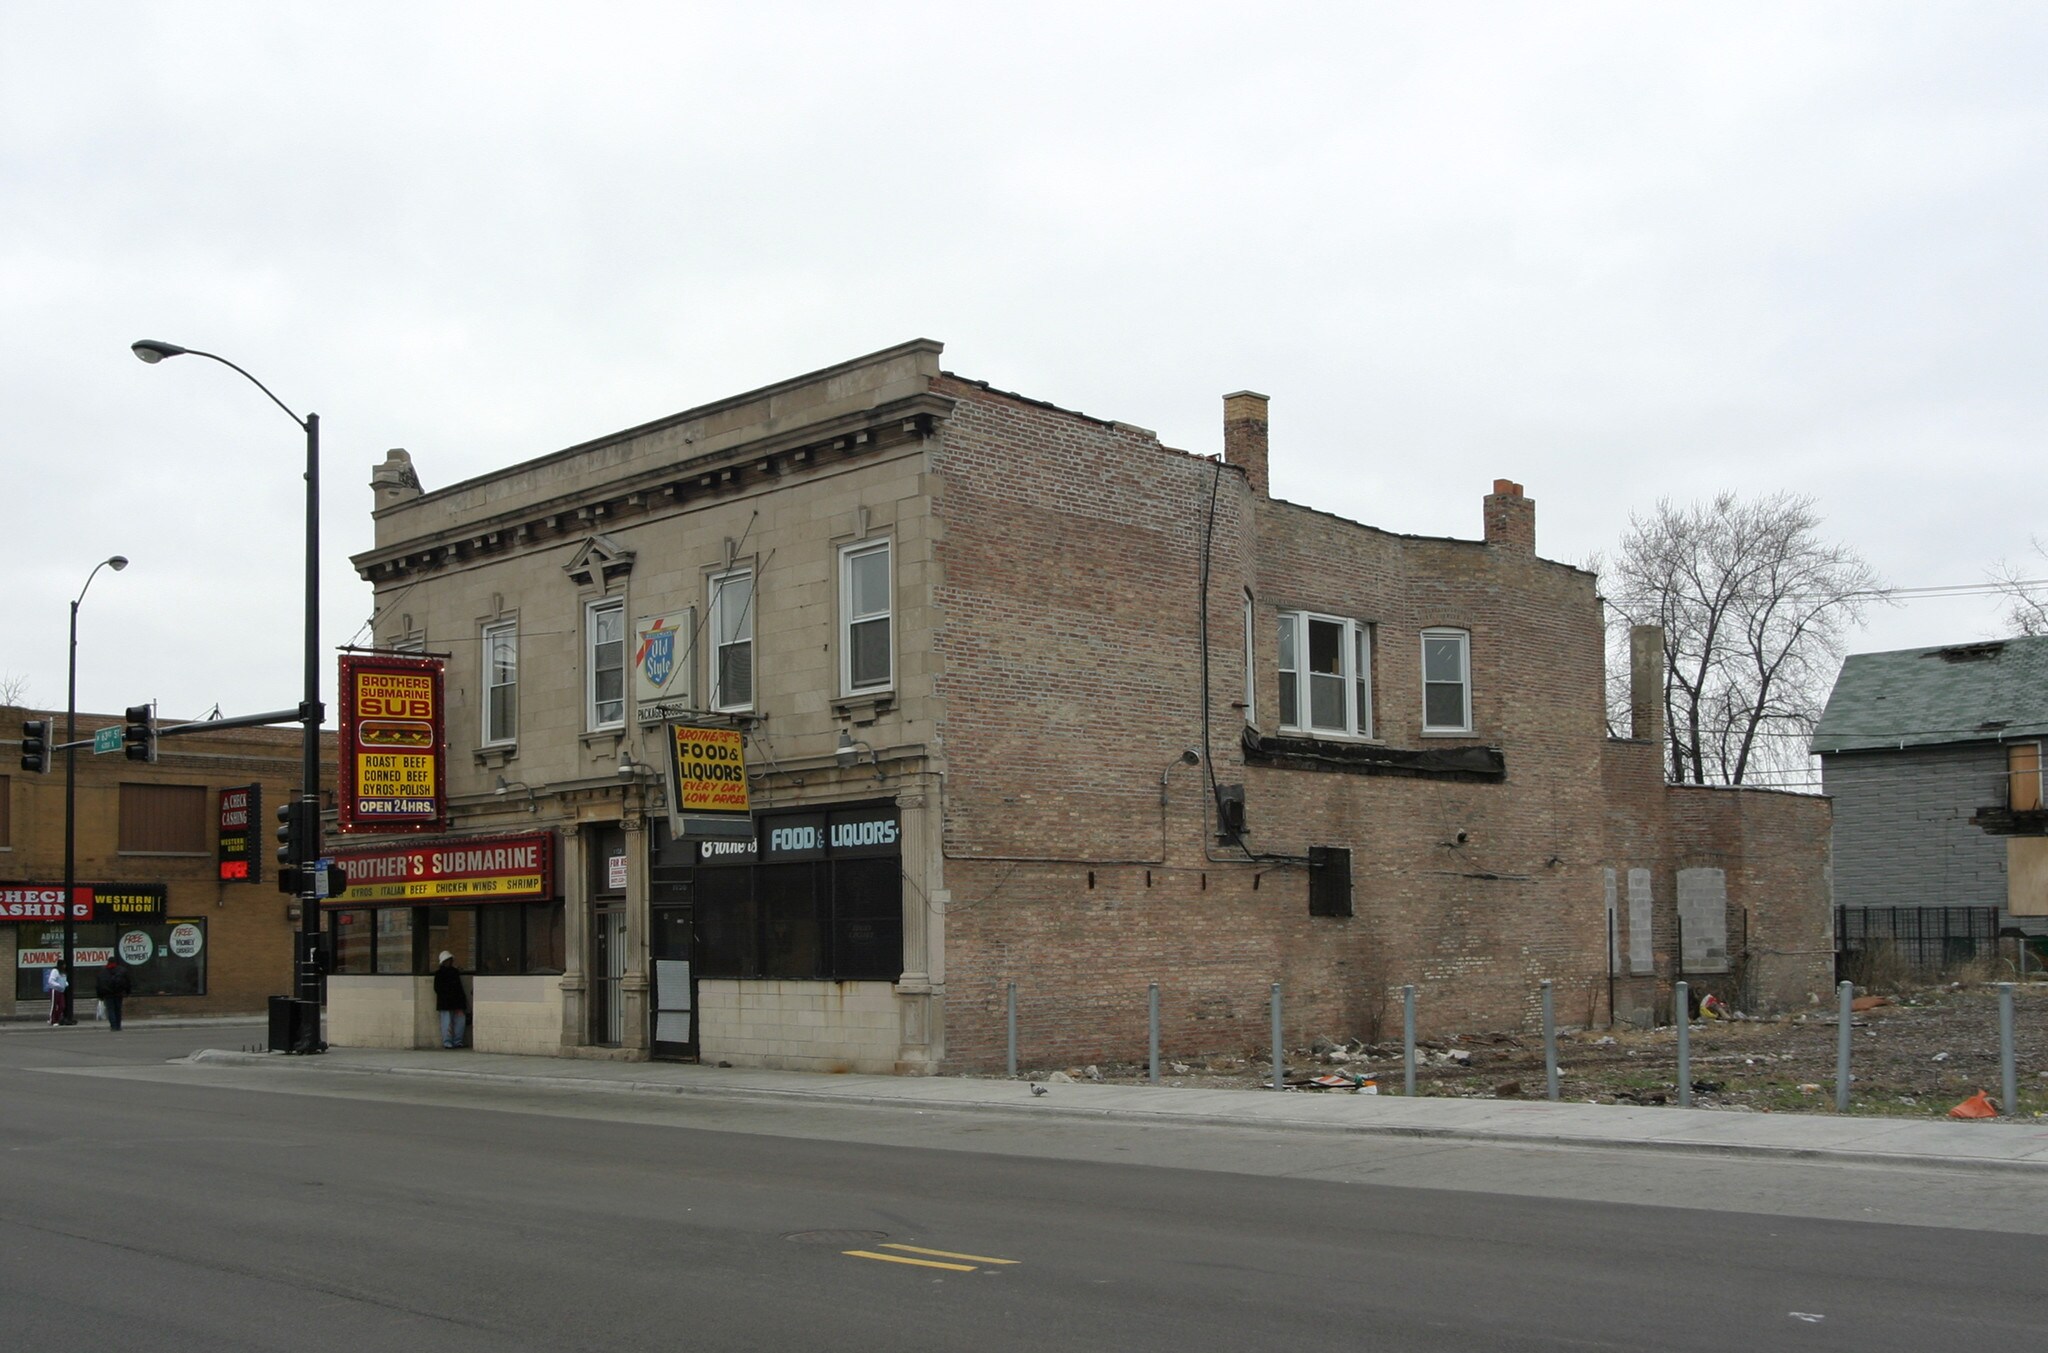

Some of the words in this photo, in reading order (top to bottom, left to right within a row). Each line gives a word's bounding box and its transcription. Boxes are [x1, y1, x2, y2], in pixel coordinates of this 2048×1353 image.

[651, 638, 668, 658] Old
[647, 656, 671, 682] Style
[362, 676, 429, 689] BROTHERS
[361, 687, 430, 699] SUBMARINE
[361, 698, 430, 717] SUB
[680, 743, 728, 760] FOOD
[729, 748, 739, 761] &
[366, 755, 397, 767] ROAST
[403, 756, 427, 768] BEEF
[364, 770, 401, 782] CORNED
[407, 770, 428, 782] BEEF
[680, 762, 743, 782] LIQUORS
[683, 781, 718, 791] EVERY
[720, 783, 744, 793] DAY
[230, 793, 247, 809] CHECK
[684, 793, 709, 803] LOW
[712, 794, 746, 805] PRICES
[360, 801, 392, 813] OPEN
[222, 810, 248, 826] CASHING
[771, 826, 815, 851] FOOD
[831, 820, 896, 847] LIQUORS
[432, 846, 537, 874] SUBMARINE
[351, 887, 373, 897] GYROS
[381, 885, 406, 896] ITALIAN
[410, 884, 428, 895] BEEF
[435, 882, 468, 893] CHICKEN
[472, 881, 497, 892] WINGS
[507, 878, 539, 890] SHRIMP
[0, 890, 65, 903] HEC
[94, 895, 152, 904] WESTERN
[0, 903, 88, 916] ASHING
[113, 904, 152, 912] UNION
[123, 933, 144, 945] FREE
[22, 951, 62, 965] ADVANCE
[75, 951, 110, 963] PAYDAY
